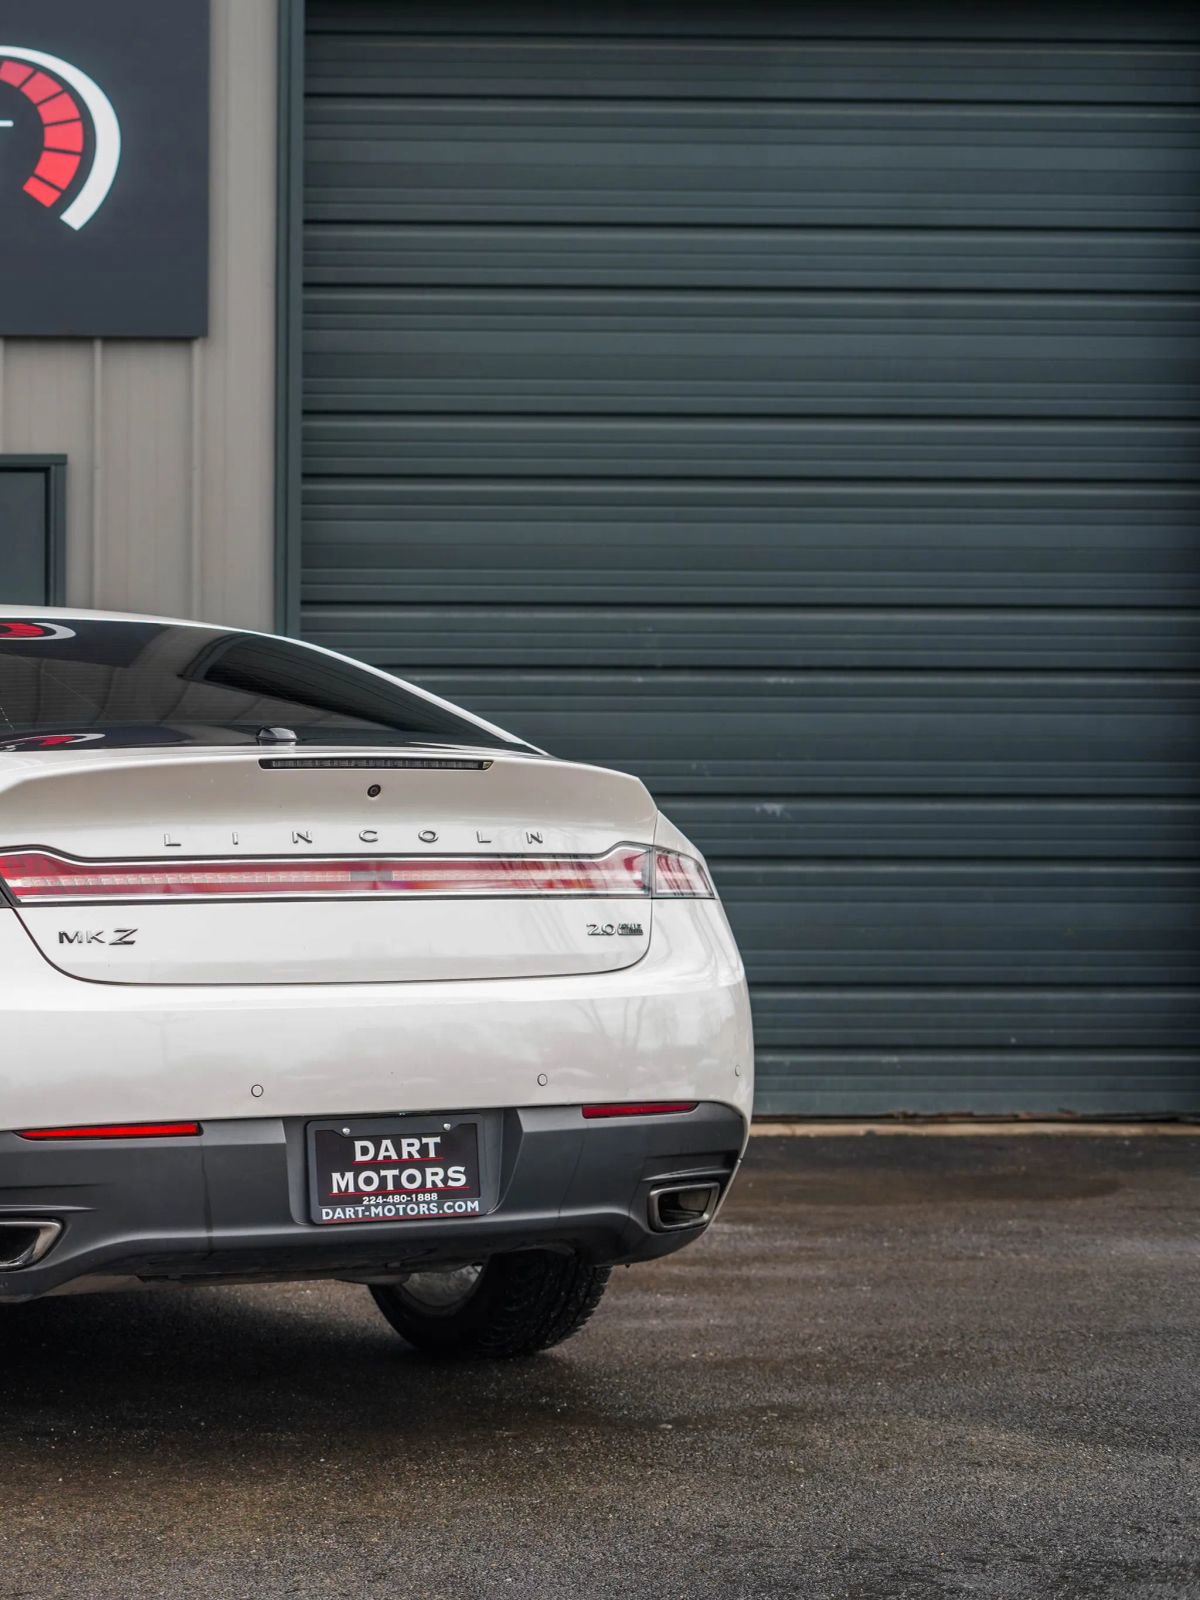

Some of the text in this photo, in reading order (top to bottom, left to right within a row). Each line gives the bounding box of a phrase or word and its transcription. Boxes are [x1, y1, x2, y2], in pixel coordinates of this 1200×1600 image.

[163, 829, 543, 847] LINCOLN
[58, 928, 138, 946] MKZ
[354, 1136, 441, 1161] DART
[331, 1166, 467, 1193] MOTORS
[362, 1193, 438, 1205] 224-480-1888
[321, 1201, 480, 1220] DART-MOTORS.COM
